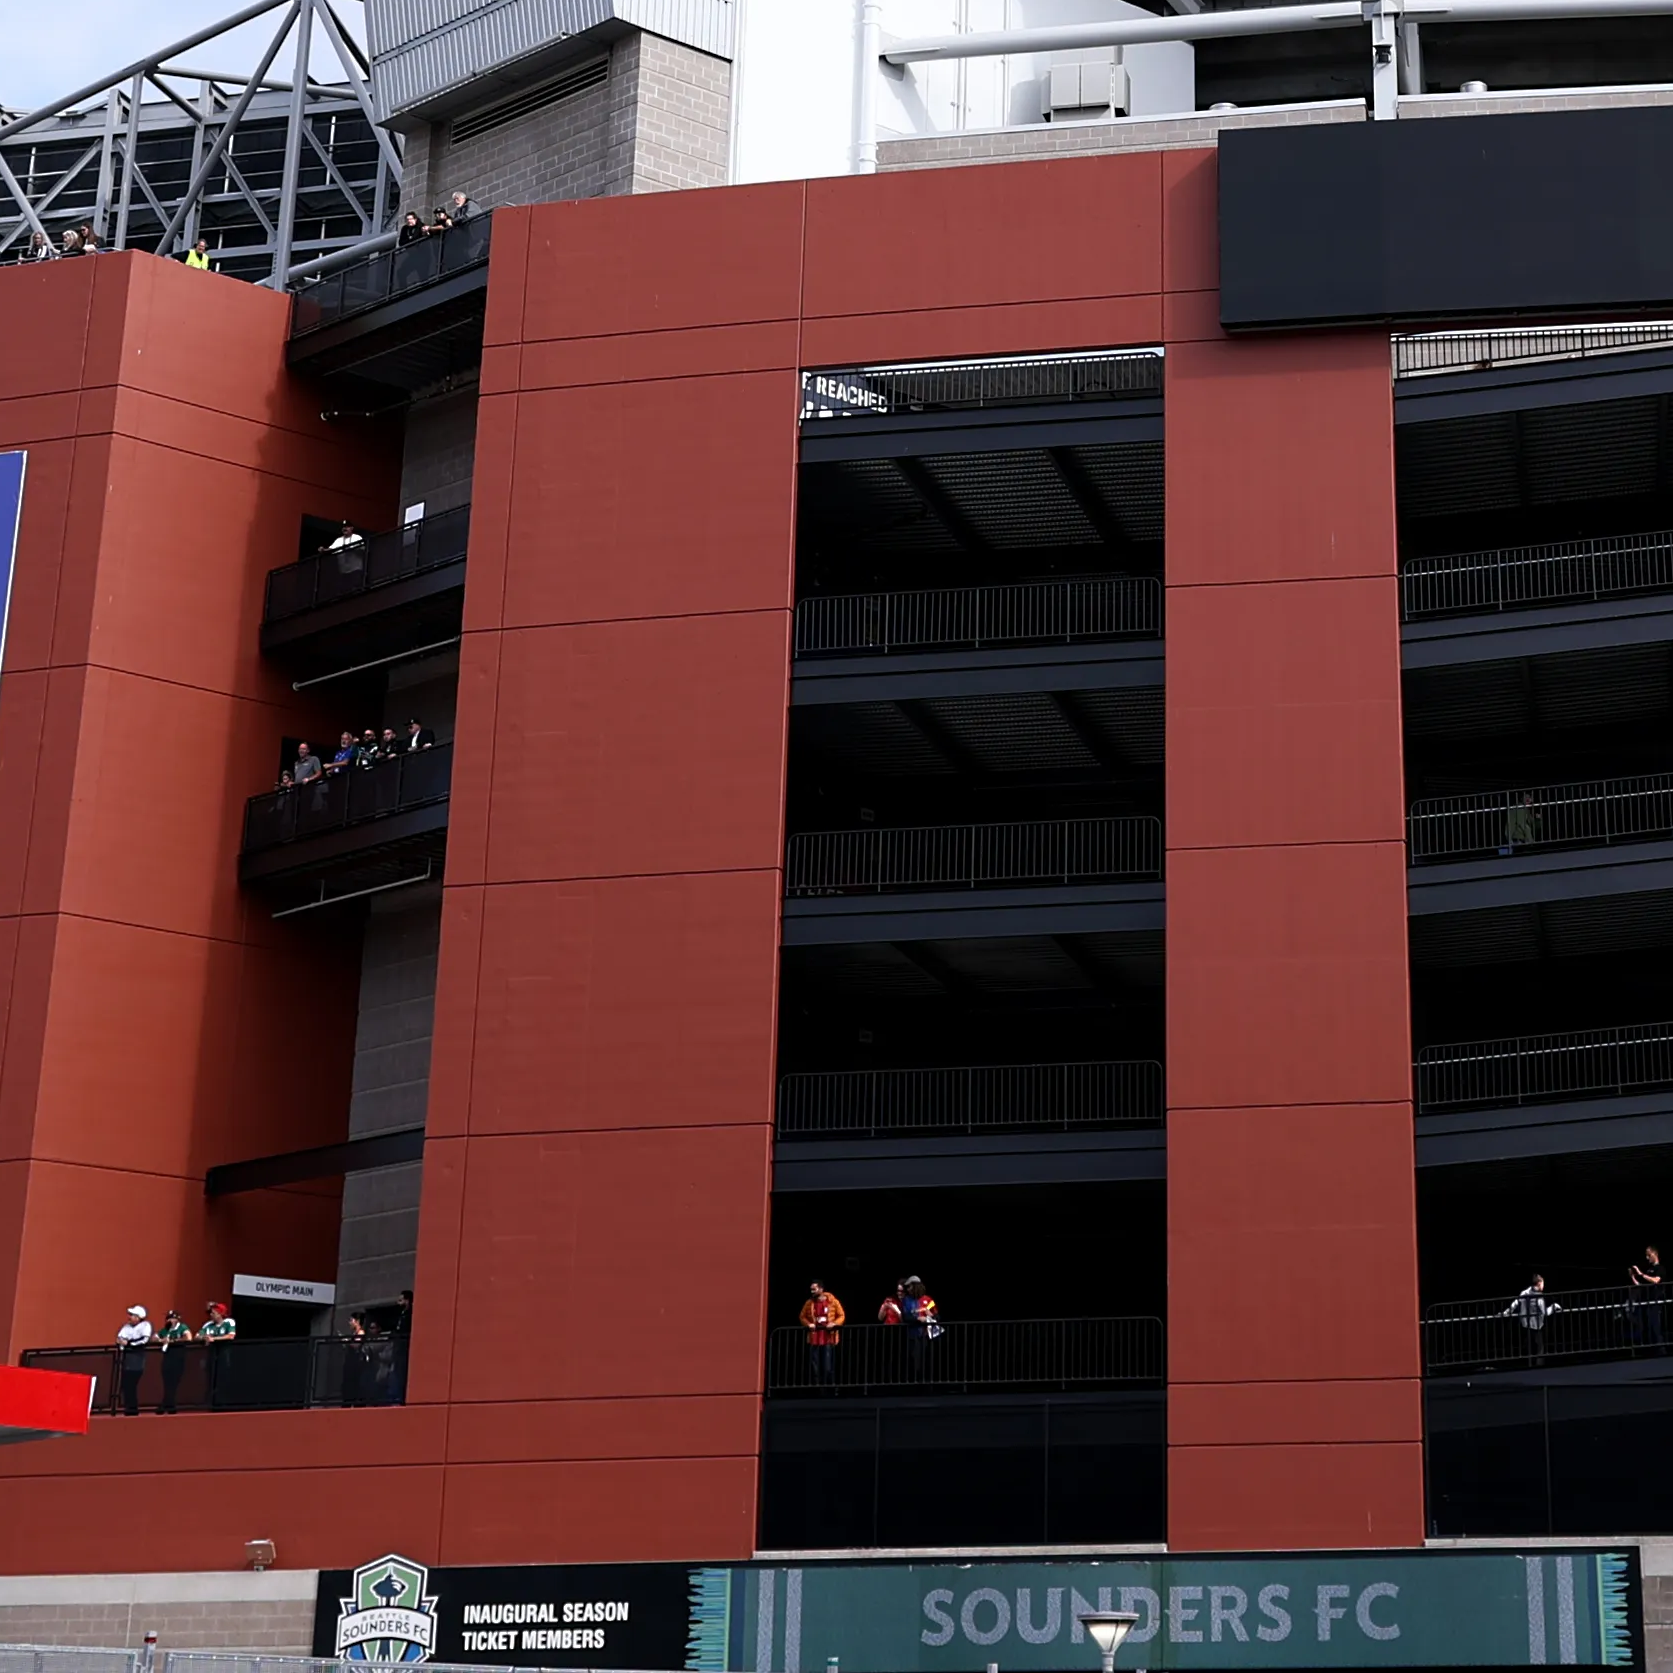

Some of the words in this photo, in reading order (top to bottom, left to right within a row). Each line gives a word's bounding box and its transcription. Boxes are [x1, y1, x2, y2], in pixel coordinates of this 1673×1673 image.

[816, 376, 888, 413] REACHED
[256, 1282, 291, 1295] OLYMPIC
[292, 1286, 314, 1297] MAIN
[463, 1604, 558, 1624] INAUGURAL
[562, 1602, 629, 1623] SEASON
[920, 1583, 1291, 1647] SOUNDERS
[1311, 1582, 1401, 1642] FC
[342, 1620, 410, 1642] SOUNDERS
[413, 1624, 428, 1641] FC
[462, 1630, 518, 1651] TICKET
[521, 1628, 605, 1650] MEMBERS
